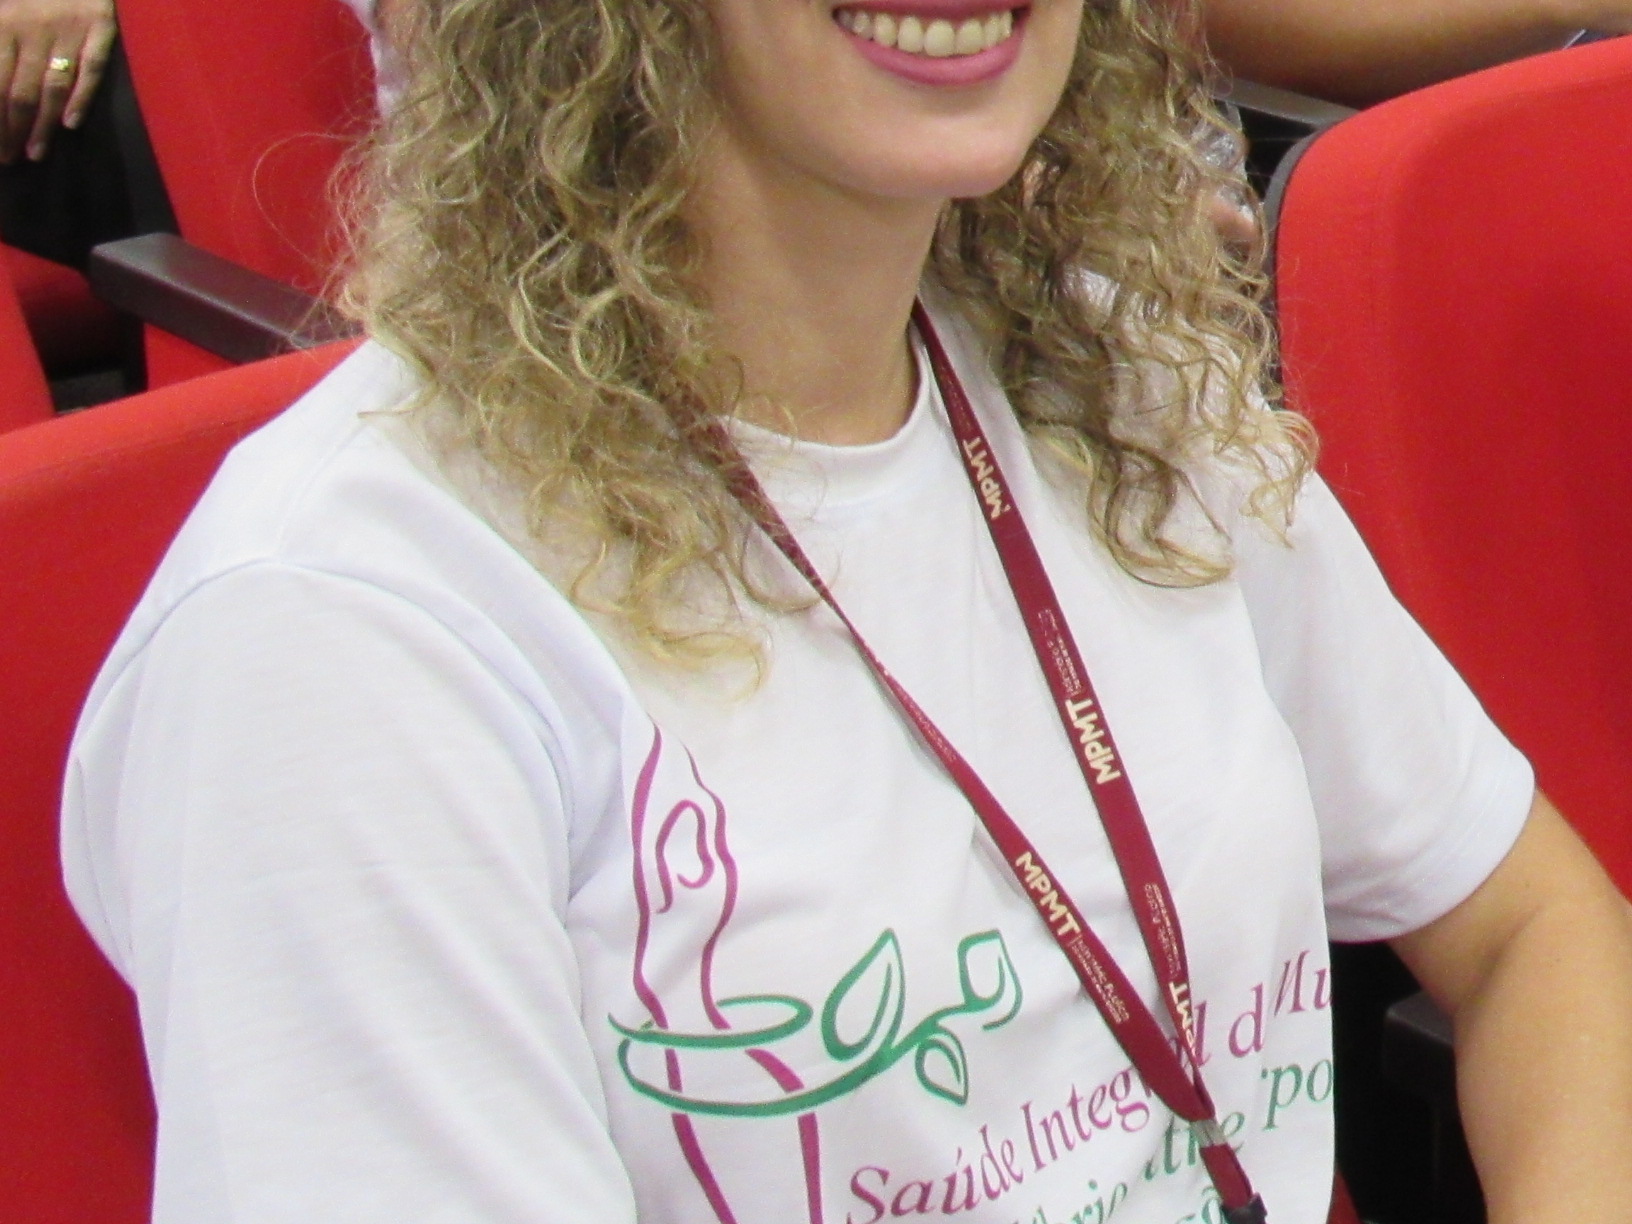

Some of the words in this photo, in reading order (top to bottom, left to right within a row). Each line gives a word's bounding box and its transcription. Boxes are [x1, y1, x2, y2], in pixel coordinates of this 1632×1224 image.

[963, 436, 1012, 520] MPMT
[1065, 697, 1122, 785] MPMT
[1015, 851, 1081, 936] MPMT
[847, 1124, 1024, 1224] Saúde
